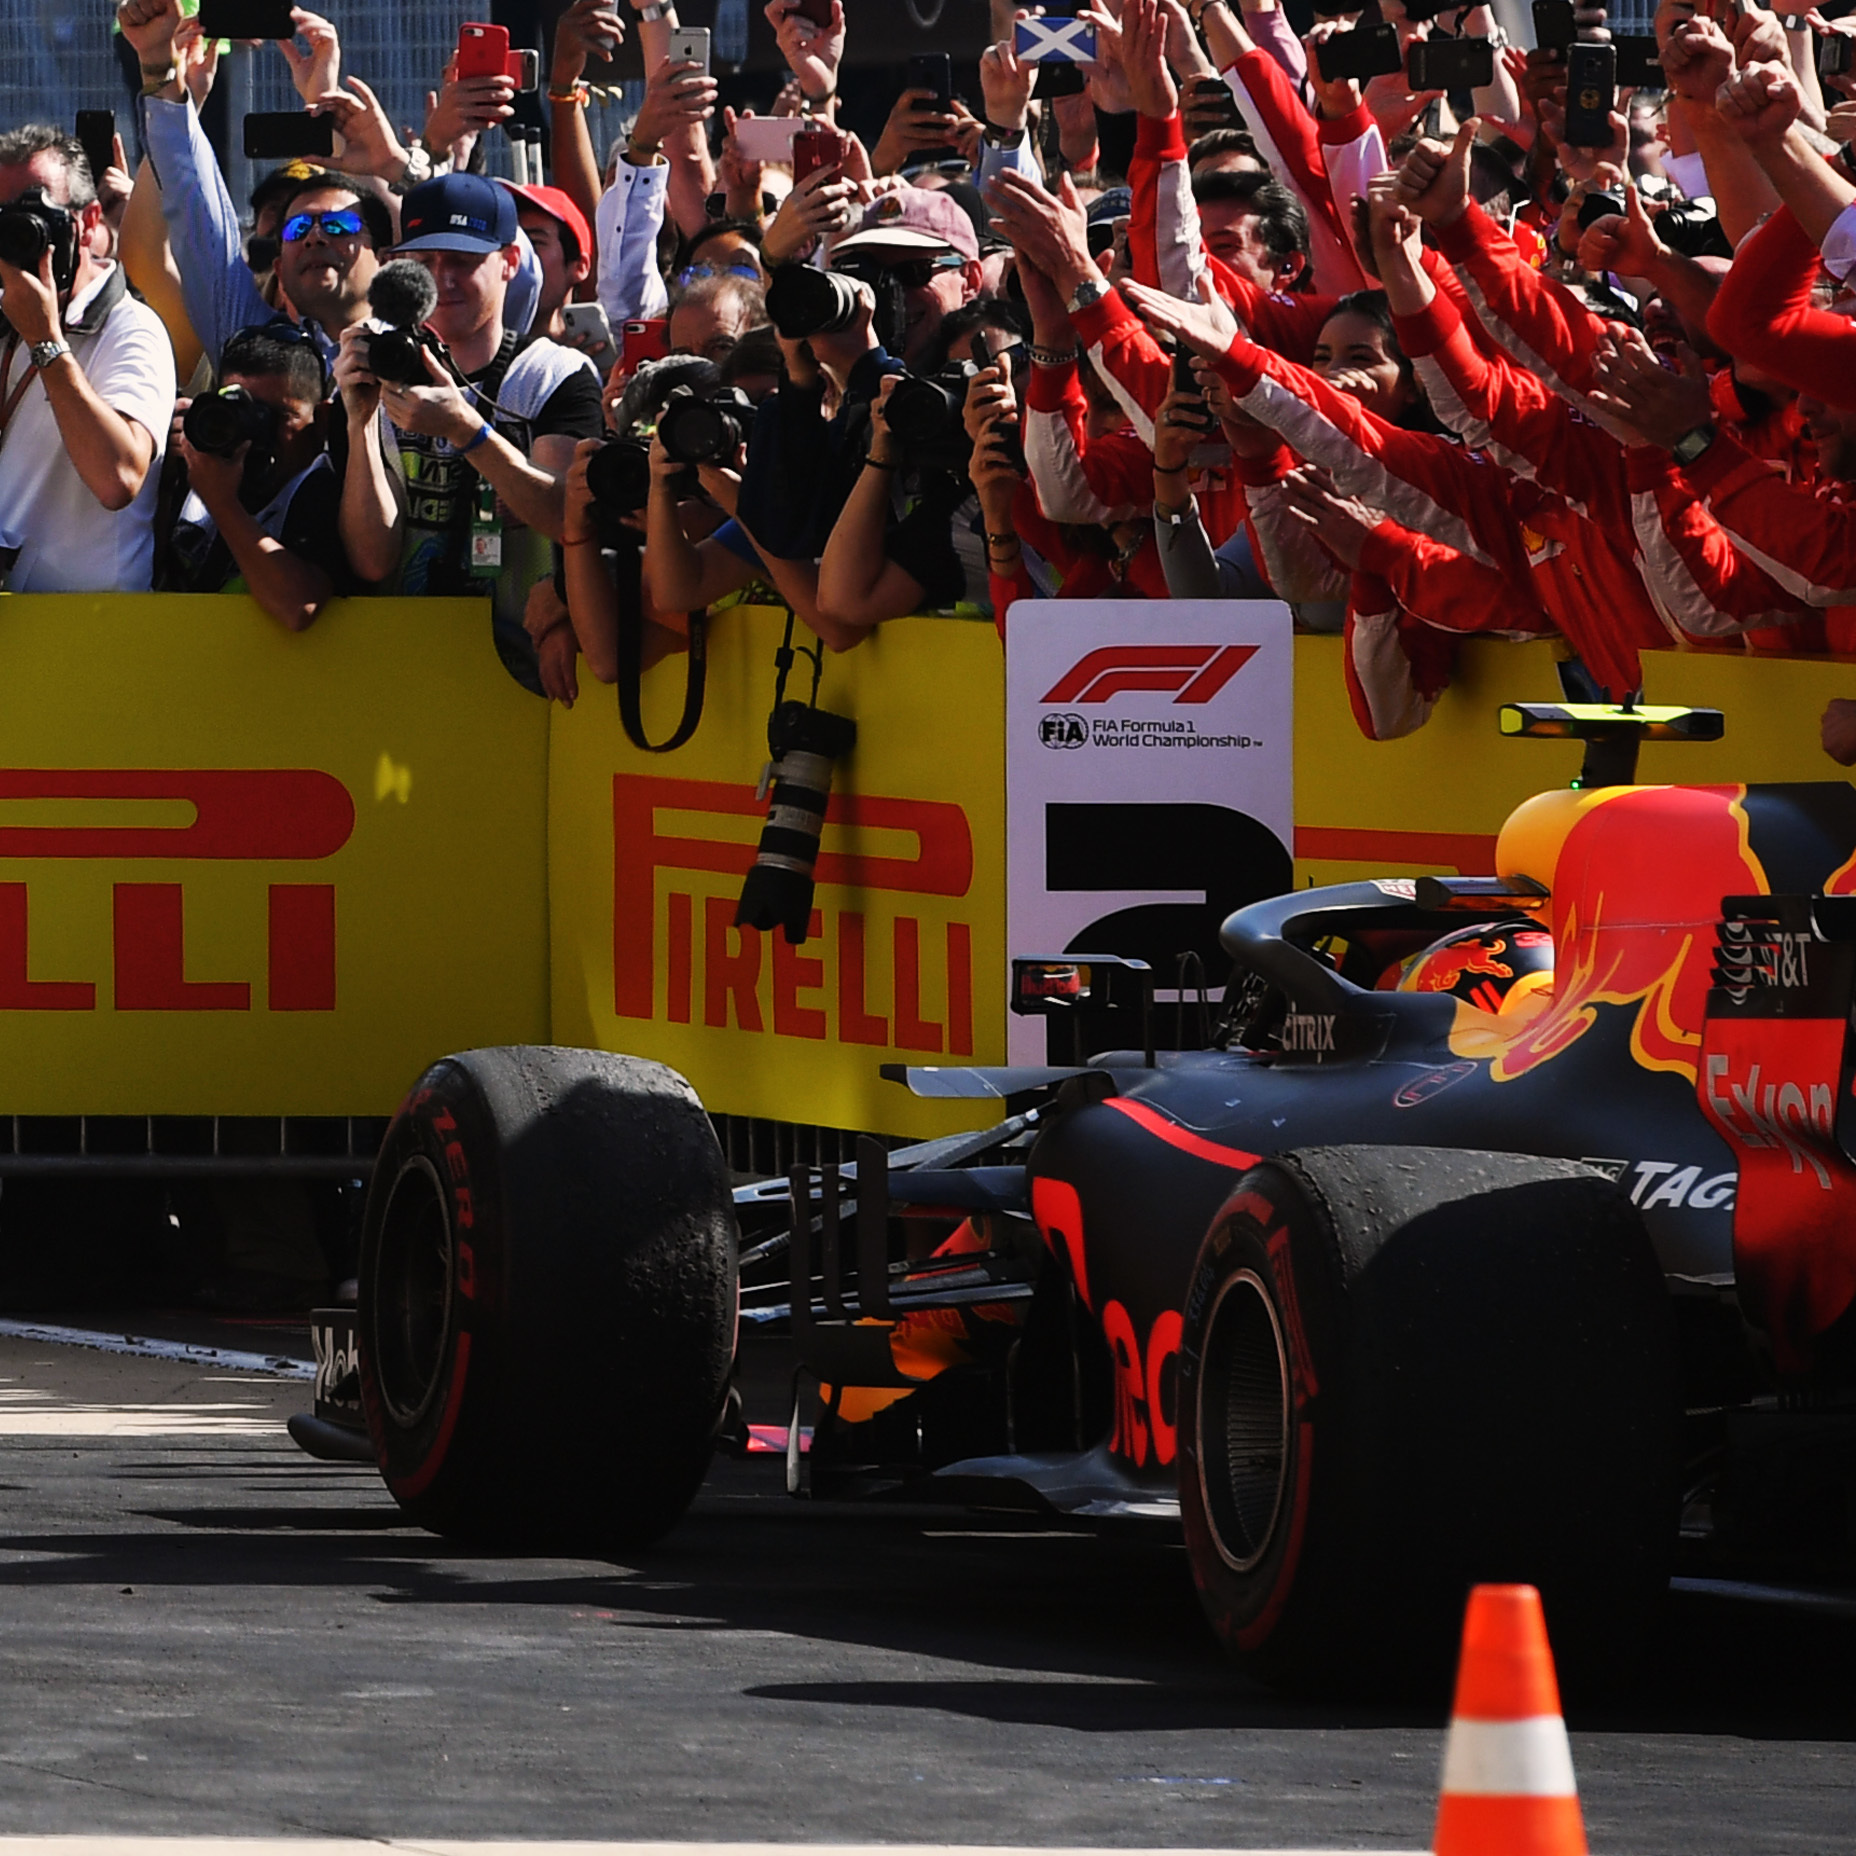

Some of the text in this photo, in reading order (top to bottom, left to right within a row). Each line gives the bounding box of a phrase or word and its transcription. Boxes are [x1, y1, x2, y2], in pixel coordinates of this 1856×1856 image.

[1092, 719, 1195, 733] FIA Formula 1
[1092, 734, 1252, 750] World Championship
[611, 772, 975, 1057] PIRELLI
[1282, 1005, 1337, 1058] CITRIX
[429, 1105, 479, 1302] ZERO
[1630, 1160, 1737, 1211] TAG
